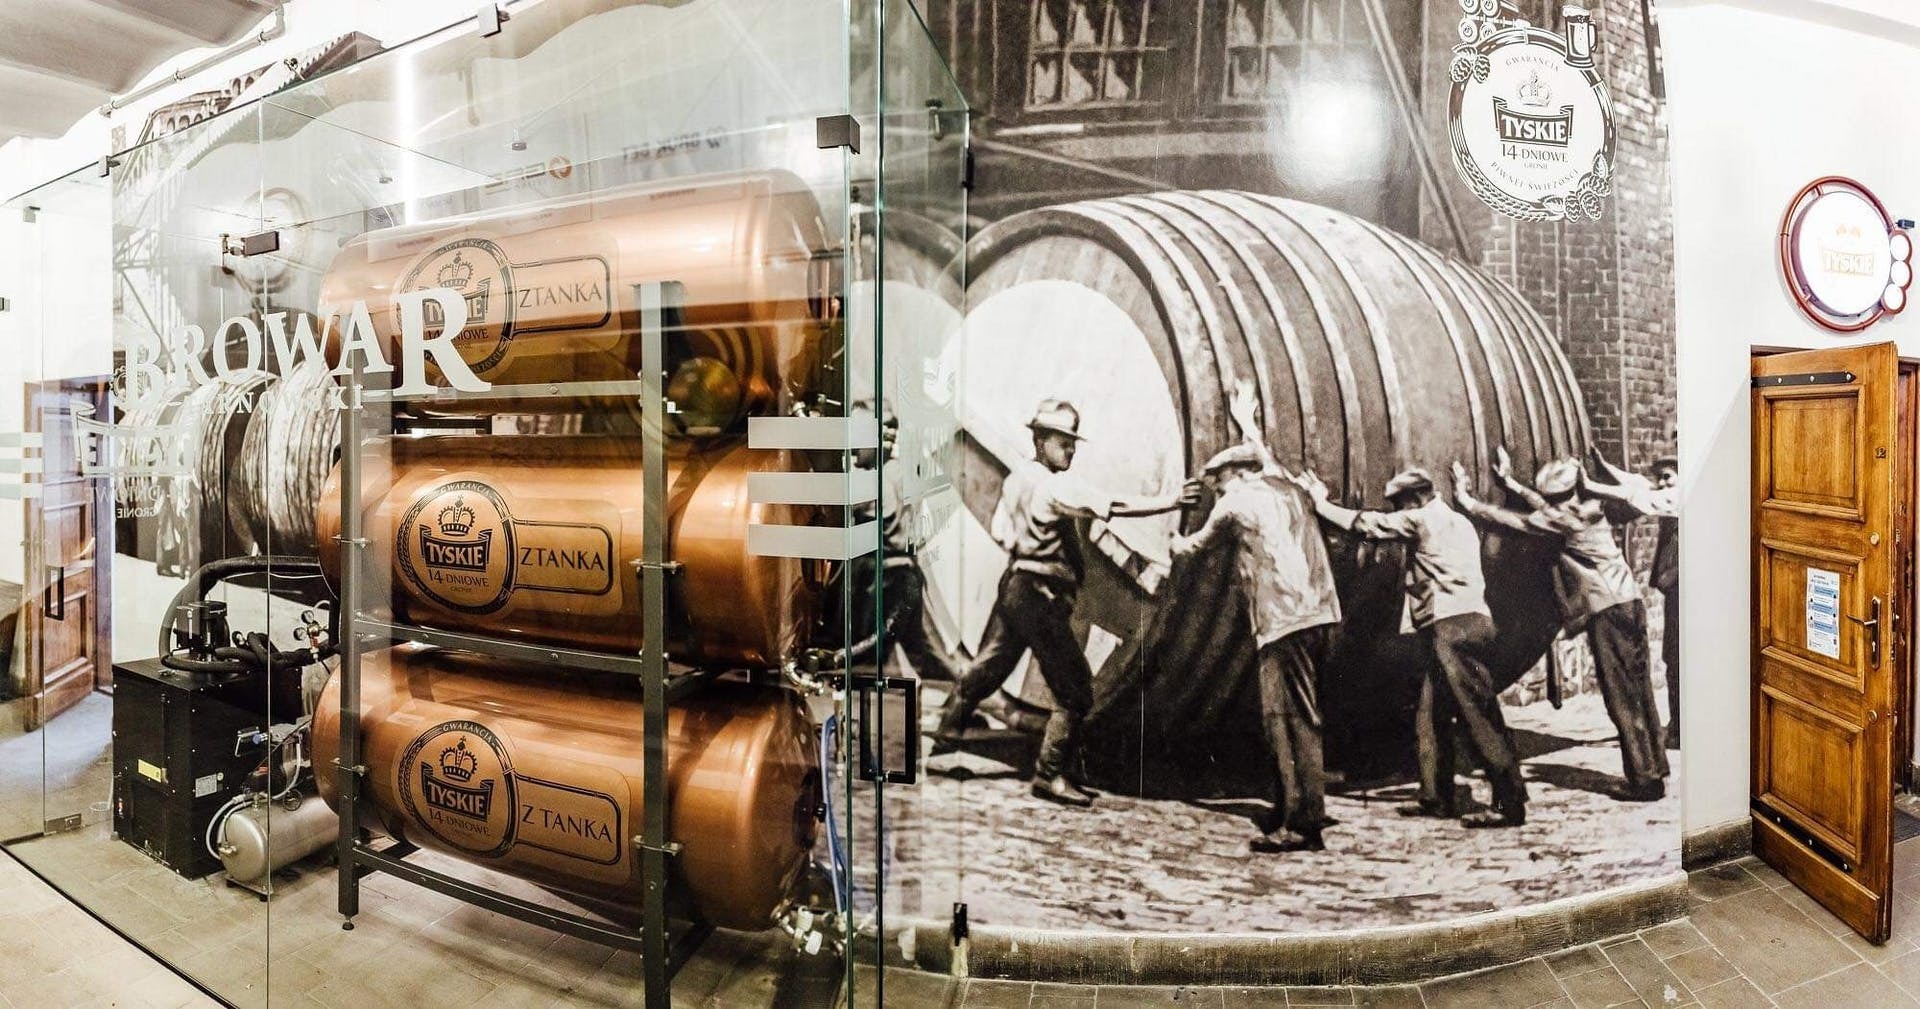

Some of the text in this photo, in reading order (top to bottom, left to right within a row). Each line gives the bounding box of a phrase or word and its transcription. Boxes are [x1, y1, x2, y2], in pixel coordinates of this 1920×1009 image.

[1502, 115, 1567, 141] TYSKIE
[1502, 143, 1569, 163] 14 DNIOWE
[425, 295, 484, 322] TYIE
[114, 287, 492, 410] BROWAR
[184, 384, 364, 416] ARNOWSKI
[427, 543, 484, 567] TYSKIE
[428, 569, 489, 587] 14 DNIOWE
[428, 780, 486, 817] TYSKIE
[428, 807, 443, 825] 14
